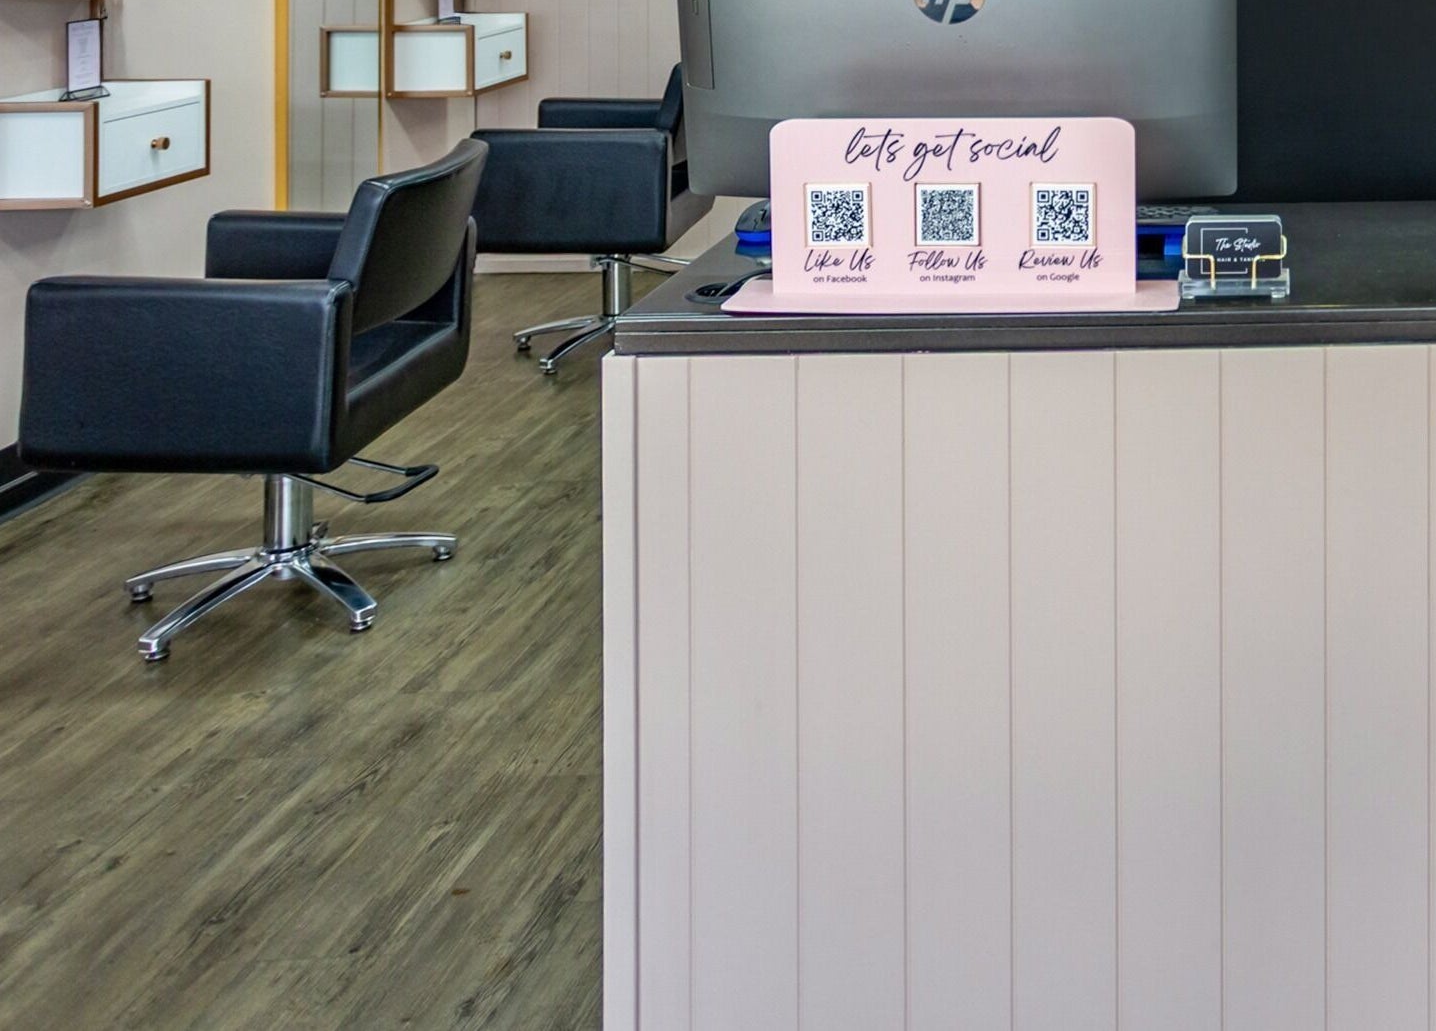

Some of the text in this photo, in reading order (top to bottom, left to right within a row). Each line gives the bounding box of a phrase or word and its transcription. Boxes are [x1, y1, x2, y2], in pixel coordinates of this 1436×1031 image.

[845, 126, 1062, 182] lets get social
[1215, 237, 1232, 251] The
[804, 247, 876, 272] Like Us
[907, 249, 989, 272] Follow Us
[1018, 247, 1104, 270] Review Us
[826, 274, 868, 283] Facebook
[932, 273, 976, 284] Instagram
[1049, 272, 1080, 283] Google
